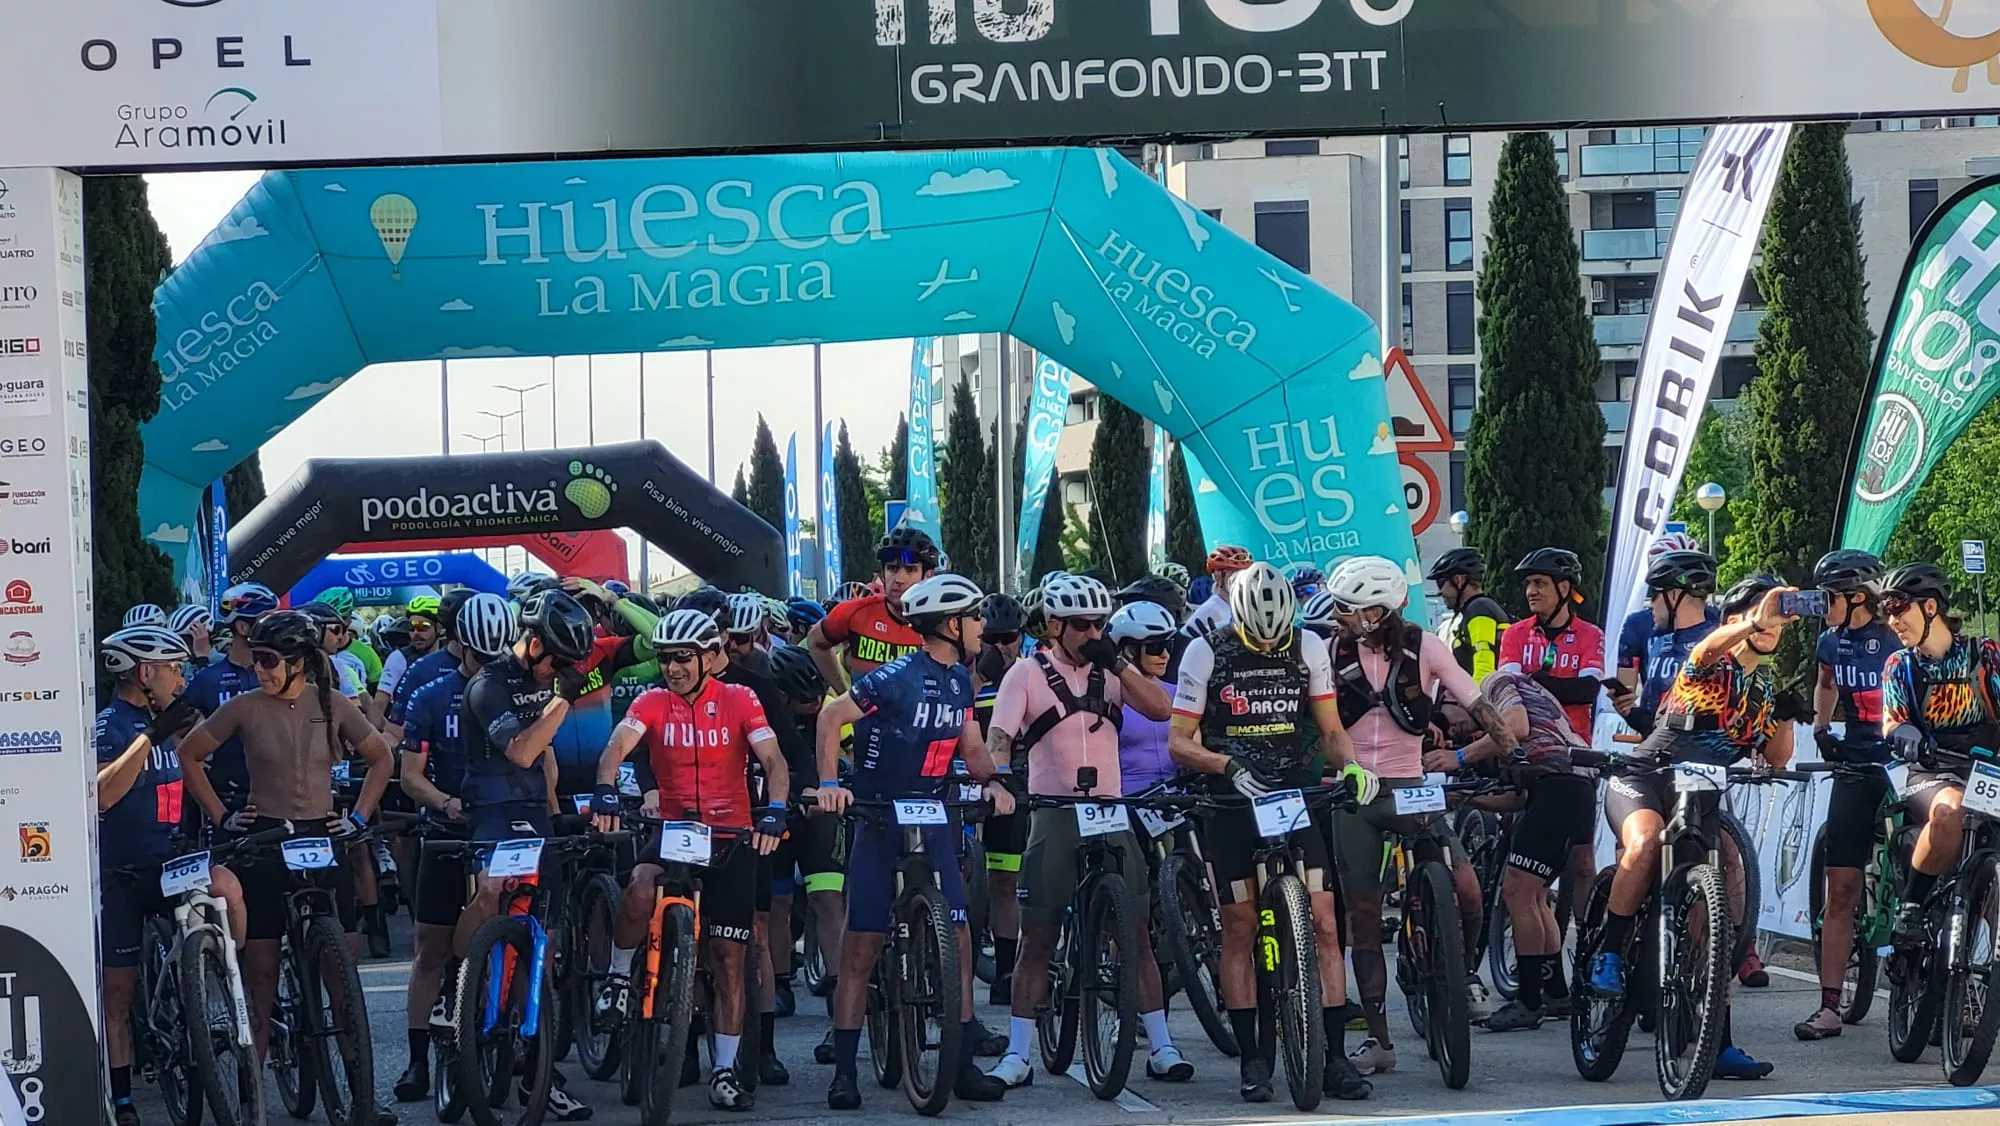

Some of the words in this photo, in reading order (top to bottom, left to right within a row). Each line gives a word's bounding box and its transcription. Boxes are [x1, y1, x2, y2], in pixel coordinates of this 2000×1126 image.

[80, 35, 312, 71] OPEL
[117, 103, 189, 122] Grupo
[475, 178, 891, 266] Huesca
[1096, 229, 1258, 353] Huesca
[1634, 277, 1725, 534] GOBIK
[0, 437, 46, 453] GEO
[1243, 415, 1345, 471] Hu
[1254, 464, 1355, 535] es
[392, 520, 461, 531] PODOLOGÍA
[464, 520, 472, 528] Y
[476, 513, 560, 527] BIOMECÁNICA
[642, 480, 665, 503] Pisa
[665, 497, 689, 522] bien,
[692, 517, 712, 536] vive
[712, 532, 745, 556] mejor
[12, 537, 51, 555] barri
[230, 565, 255, 585] Pisa
[252, 545, 280, 568] bien,
[276, 528, 297, 546] vive
[295, 500, 324, 530] mejor
[380, 558, 443, 579] GEO
[1232, 696, 1299, 716] BARON
[1974, 780, 2000, 799] 85
[903, 805, 938, 815] 879
[1084, 804, 1118, 821] 917
[1276, 805, 1287, 819] 1
[681, 834, 692, 847] 3
[298, 852, 321, 864] 12
[510, 852, 520, 862] 4
[1508, 852, 1552, 876] MONTON
[21, 882, 69, 896] ARAGÓN
